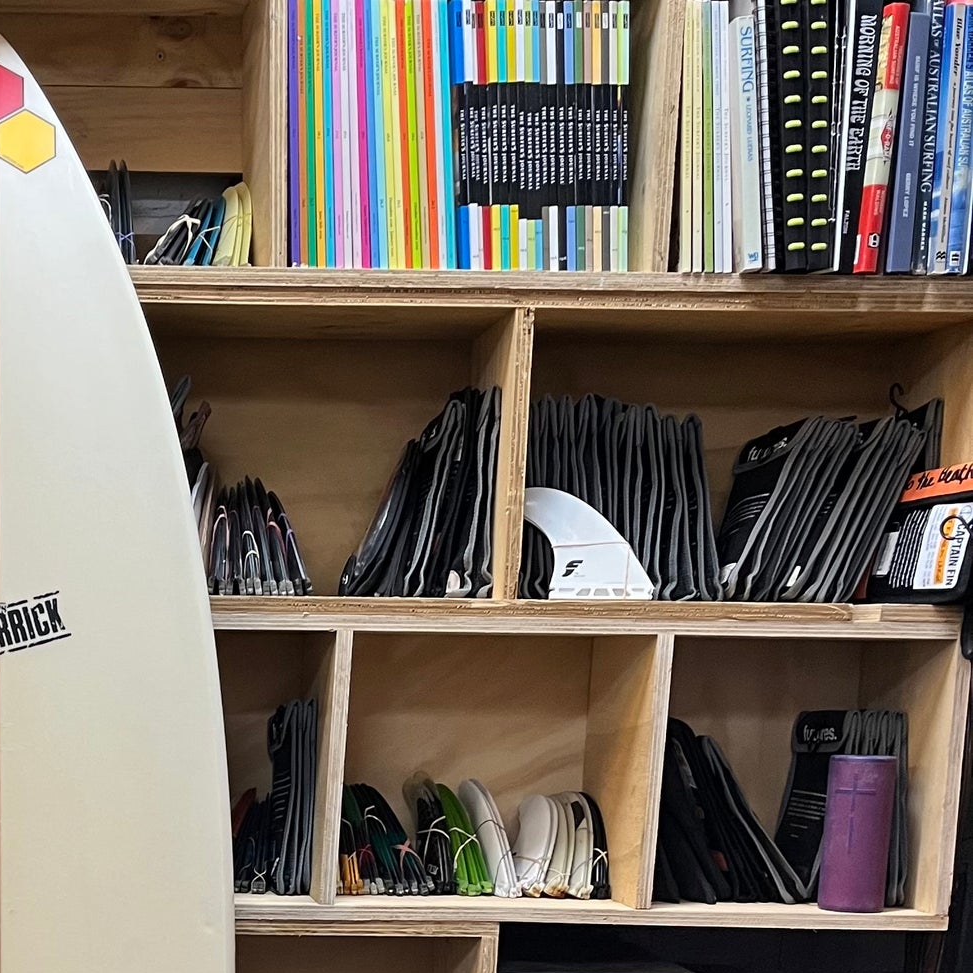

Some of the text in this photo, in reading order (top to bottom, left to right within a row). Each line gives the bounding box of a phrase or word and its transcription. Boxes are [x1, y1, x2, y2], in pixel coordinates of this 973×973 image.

[931, 0, 944, 37] ATLAS
[740, 26, 754, 93] SURFING
[845, 15, 877, 171] MORNING OF THE EARTH
[925, 50, 940, 131] AUSTRALIAN
[920, 135, 934, 192] SURFING
[916, 472, 935, 490] the
[948, 524, 966, 566] CAPTAIN
[946, 570, 956, 586] FIN
